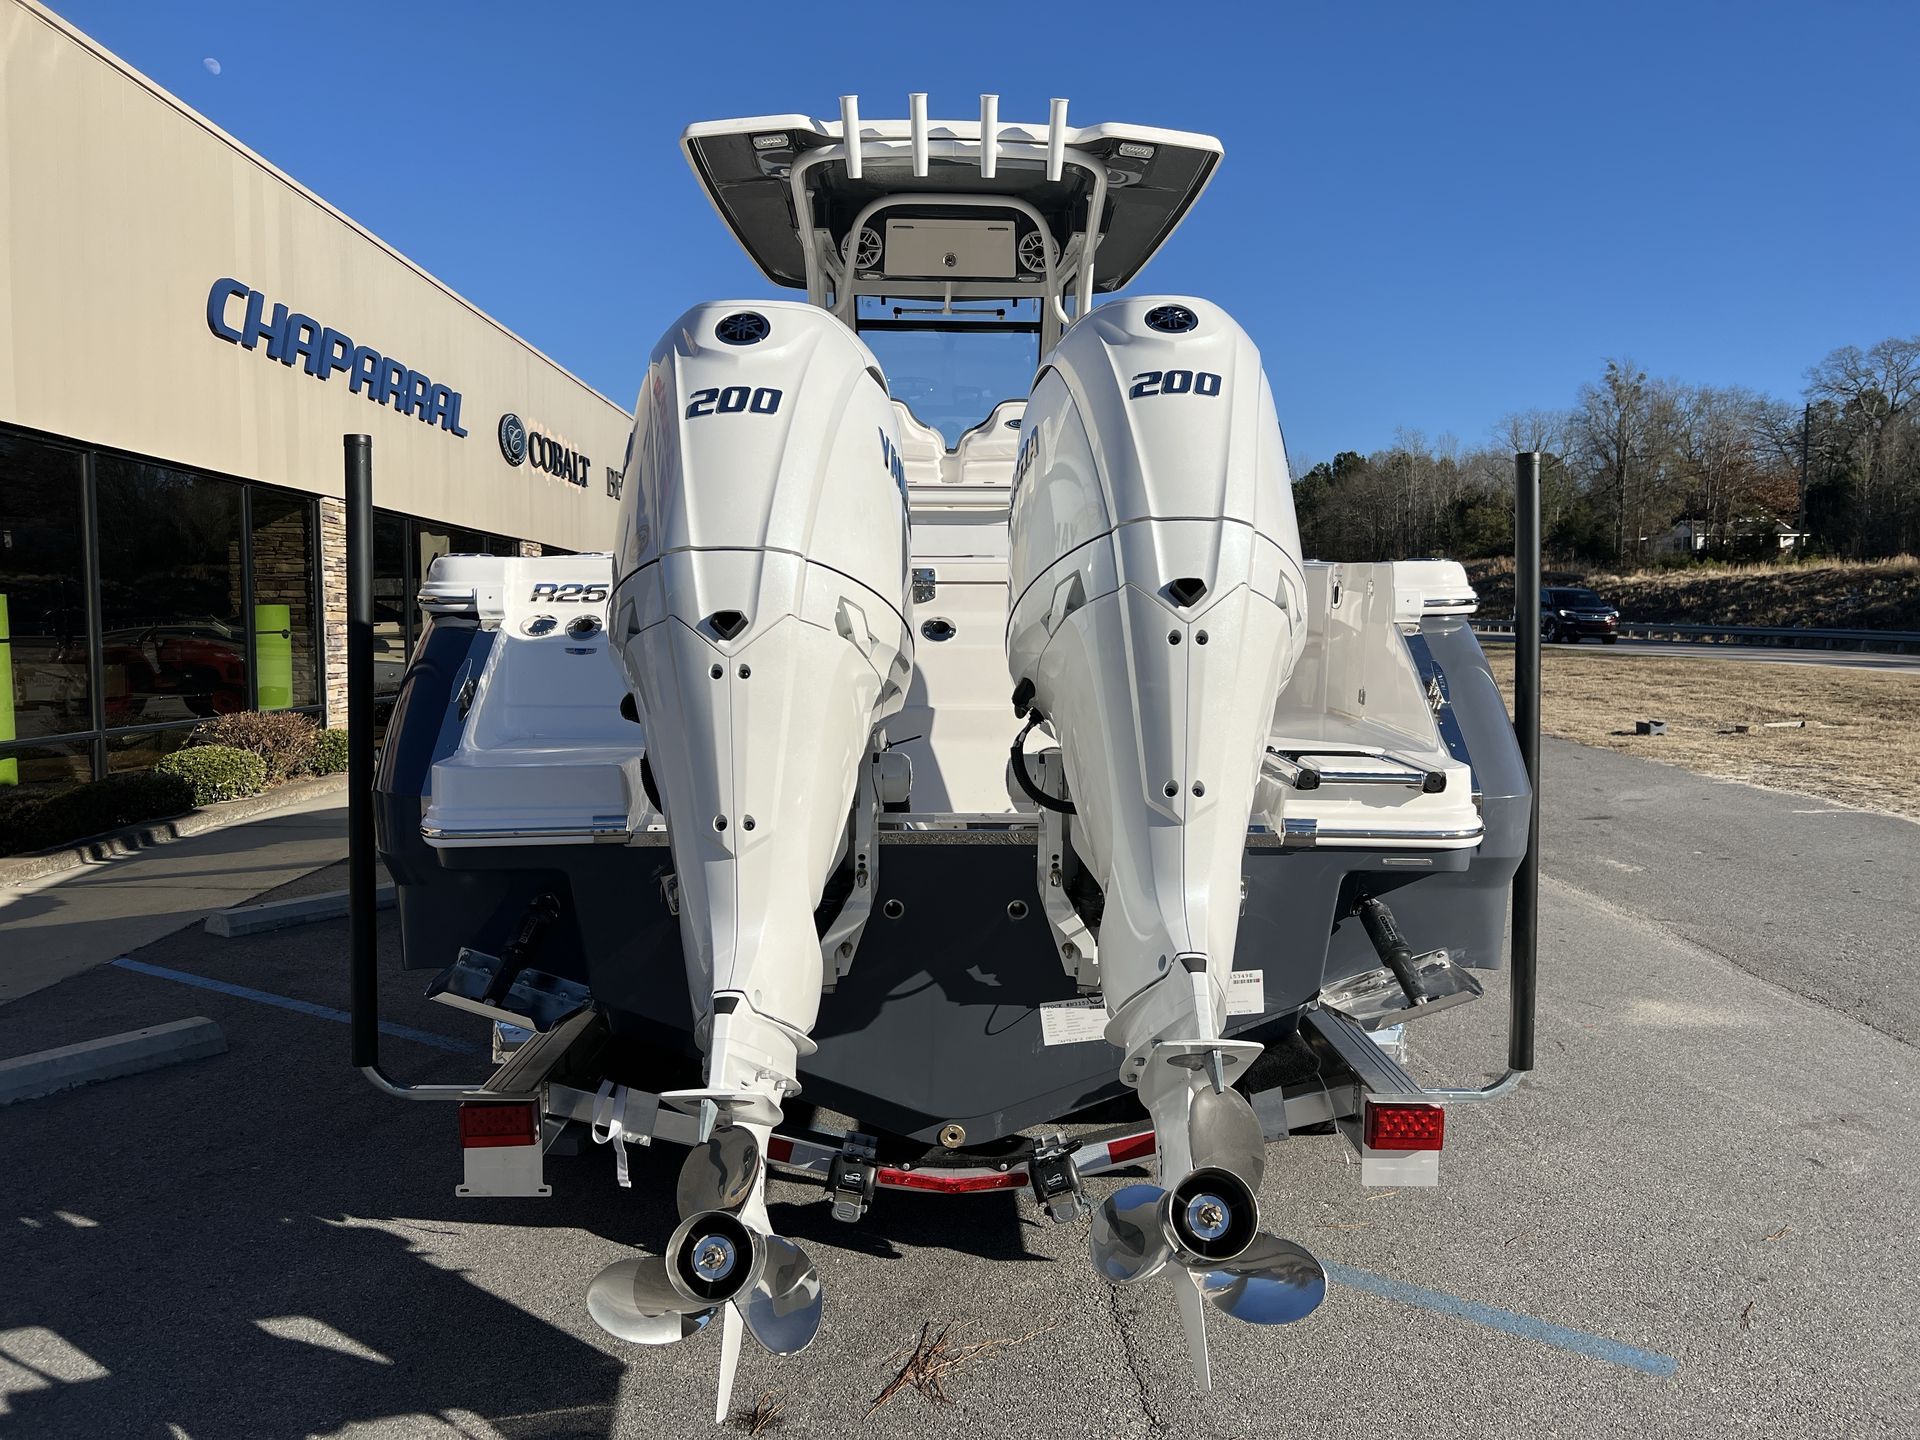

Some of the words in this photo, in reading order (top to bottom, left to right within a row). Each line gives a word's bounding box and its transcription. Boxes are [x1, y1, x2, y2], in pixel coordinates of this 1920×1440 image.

[206, 277, 468, 439] CHAPARRAL
[685, 386, 783, 421] 200
[1128, 369, 1223, 401] 200
[528, 431, 591, 489] COBALT
